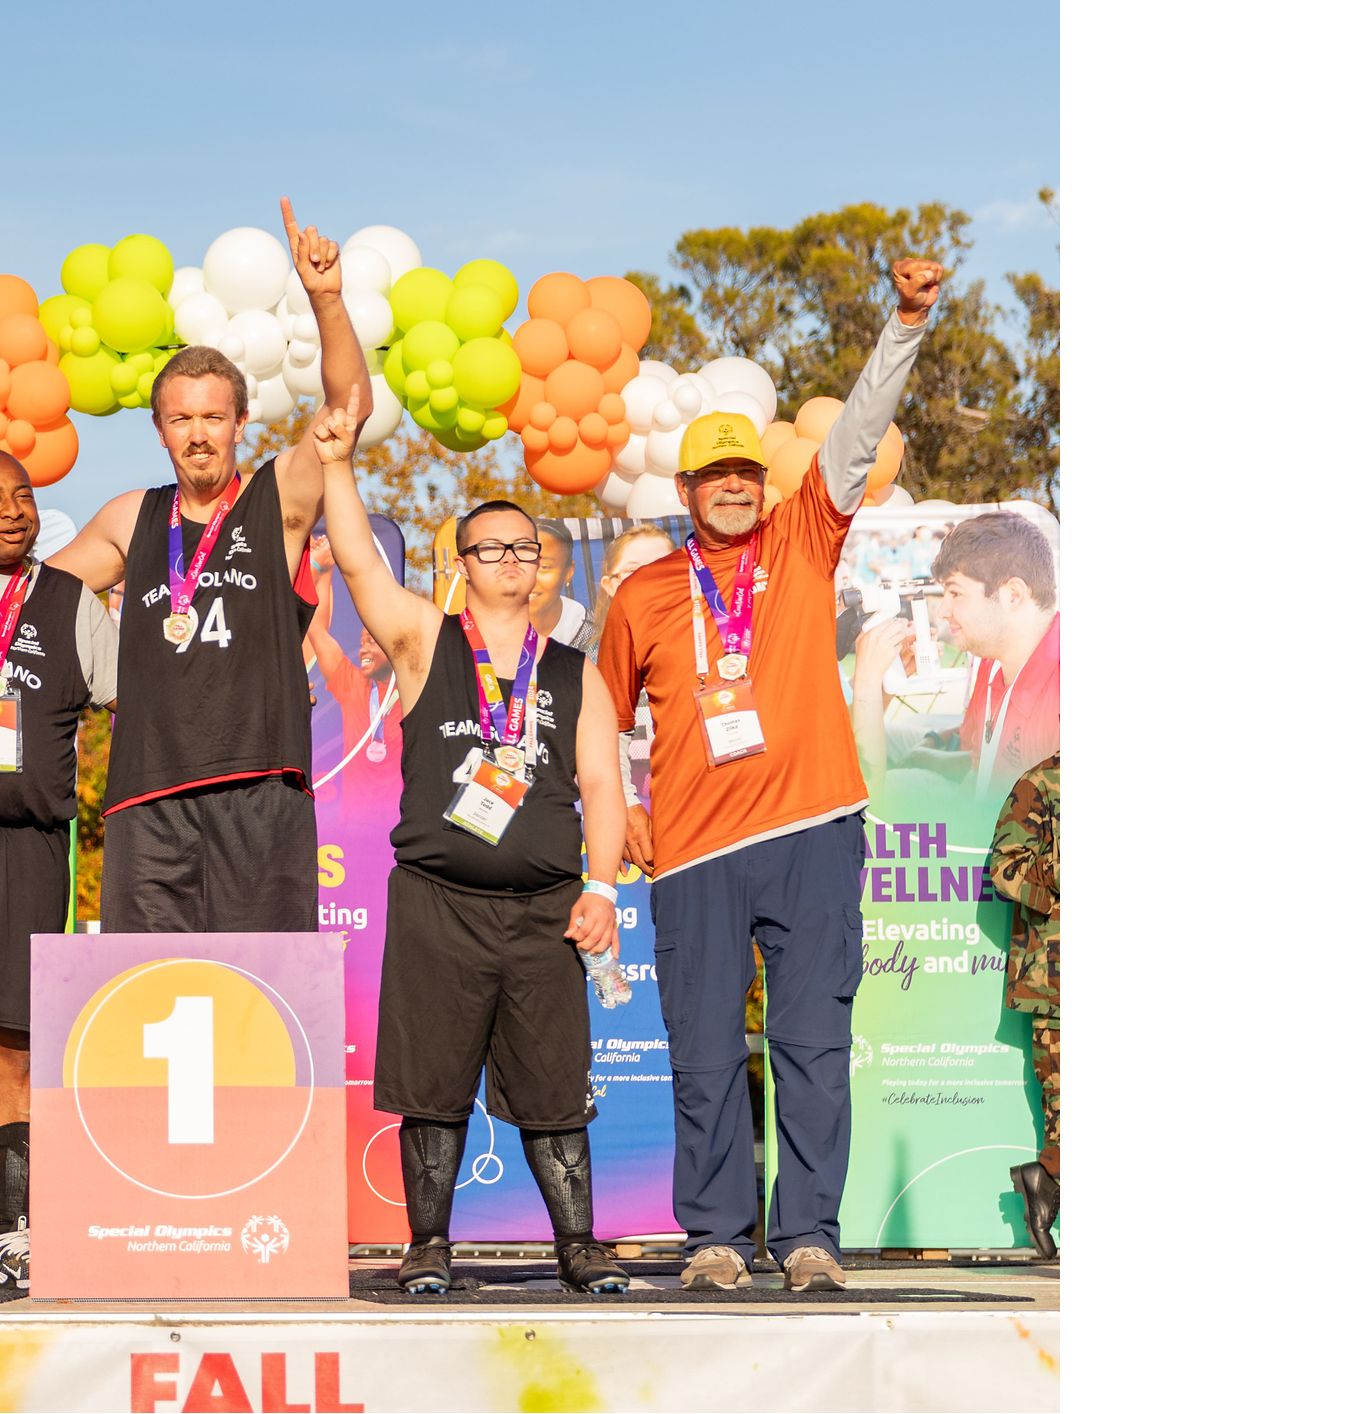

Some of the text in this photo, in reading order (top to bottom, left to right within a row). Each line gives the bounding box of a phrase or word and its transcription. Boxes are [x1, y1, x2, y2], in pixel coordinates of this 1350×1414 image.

[142, 568, 257, 608] TEA OLANO
[484, 674, 495, 690] GOLD
[509, 698, 524, 732] GAMES
[439, 720, 481, 738] TEAM
[730, 748, 748, 758] COACH
[860, 866, 1014, 902] ELLNE
[318, 902, 368, 930] ting
[862, 918, 980, 945] Elevating
[924, 950, 968, 973] and
[594, 1052, 640, 1064] California
[881, 1043, 1010, 1056] Special Olympics
[143, 996, 214, 1144] 1
[882, 1056, 974, 1068] Northern California
[595, 1074, 606, 1082] for
[882, 1092, 985, 1106] #CelebrateInclusion
[88, 1226, 232, 1239] Special Olympics
[127, 1240, 231, 1253] Northern California
[130, 1352, 364, 1414] FALL
